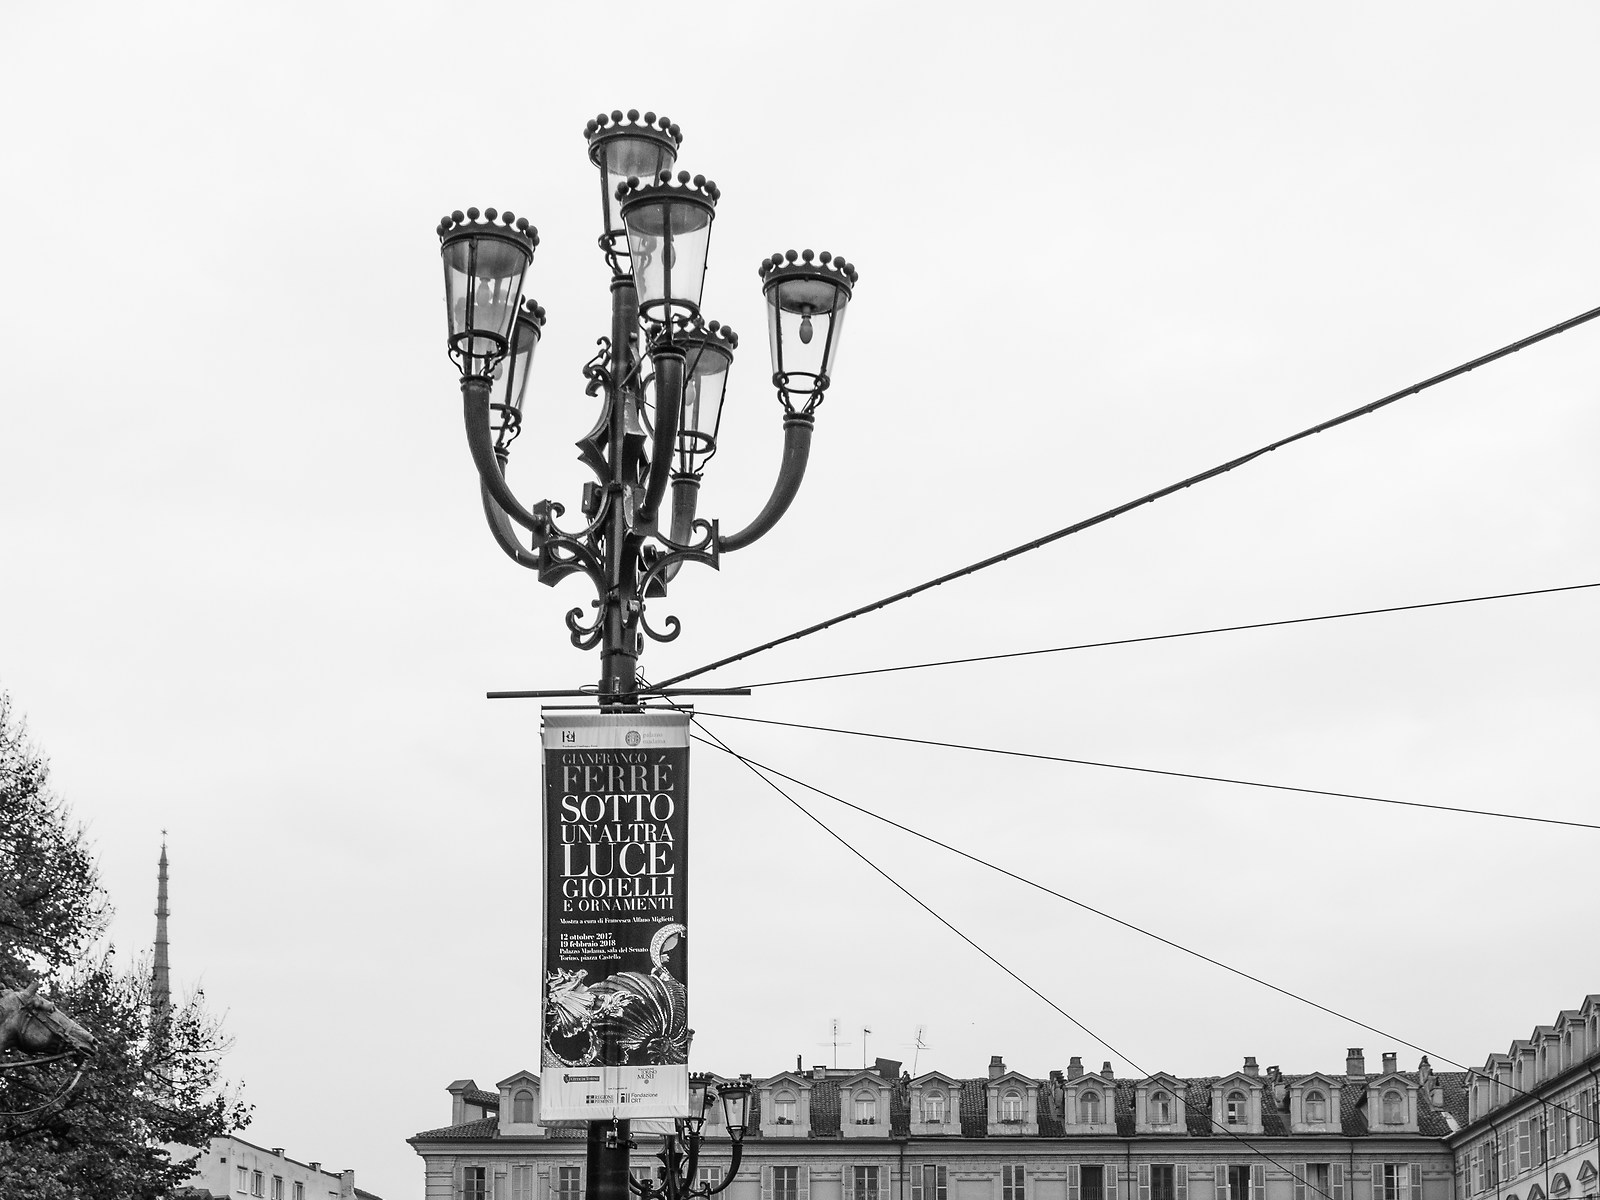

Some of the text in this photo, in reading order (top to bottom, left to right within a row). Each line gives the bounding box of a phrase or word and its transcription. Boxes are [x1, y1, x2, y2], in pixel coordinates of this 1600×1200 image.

[562, 752, 648, 764] GIANFRANCO
[561, 755, 674, 793] FERRÉ
[560, 793, 675, 823] SOTTO
[560, 824, 675, 843] UN'ALTRA
[560, 842, 675, 877] LUCE
[562, 877, 674, 898] GIOIELLI
[563, 898, 674, 912] E ORNAMENTI
[651, 915, 674, 924] Miglietti
[596, 932, 613, 940] 2017
[599, 939, 616, 947] 2018
